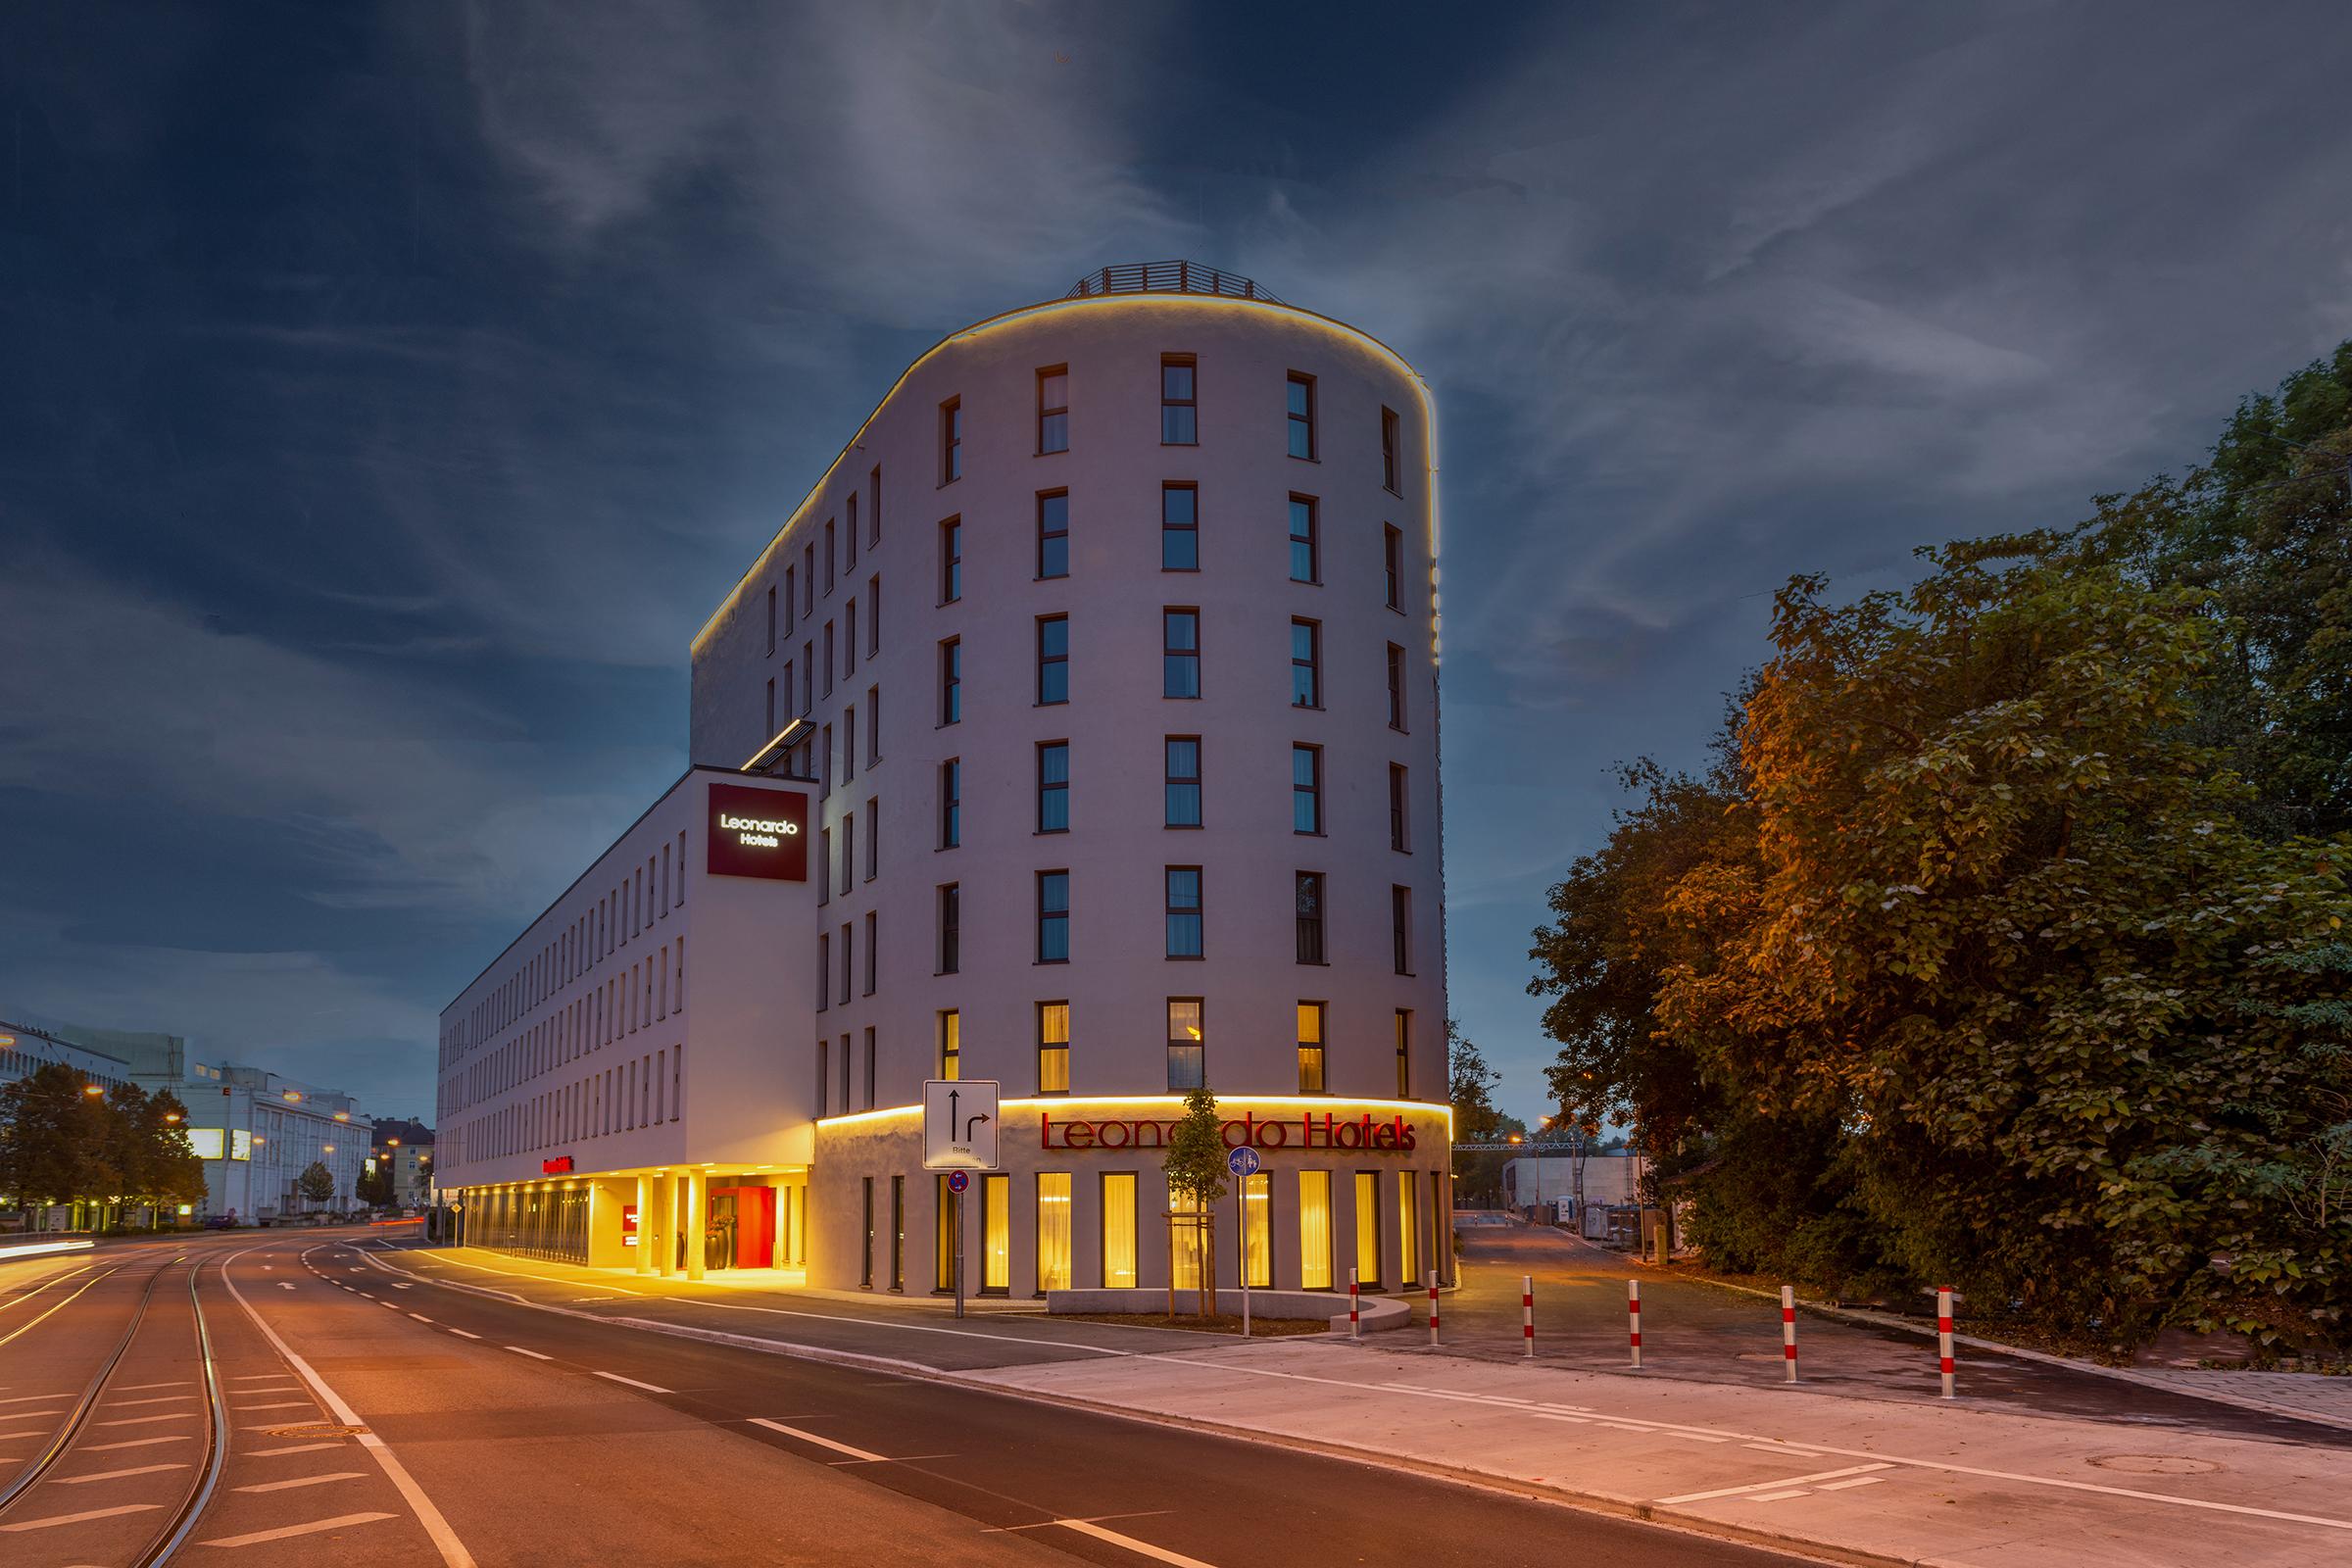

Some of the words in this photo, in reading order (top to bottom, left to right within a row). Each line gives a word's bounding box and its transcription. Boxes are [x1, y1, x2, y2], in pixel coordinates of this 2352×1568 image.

[720, 813, 798, 835] Leonardo
[740, 833, 778, 848] Hotels
[1042, 1111, 1287, 1150] Leondo
[1303, 1112, 1416, 1152] Hotels
[953, 1146, 971, 1154] Bitte
